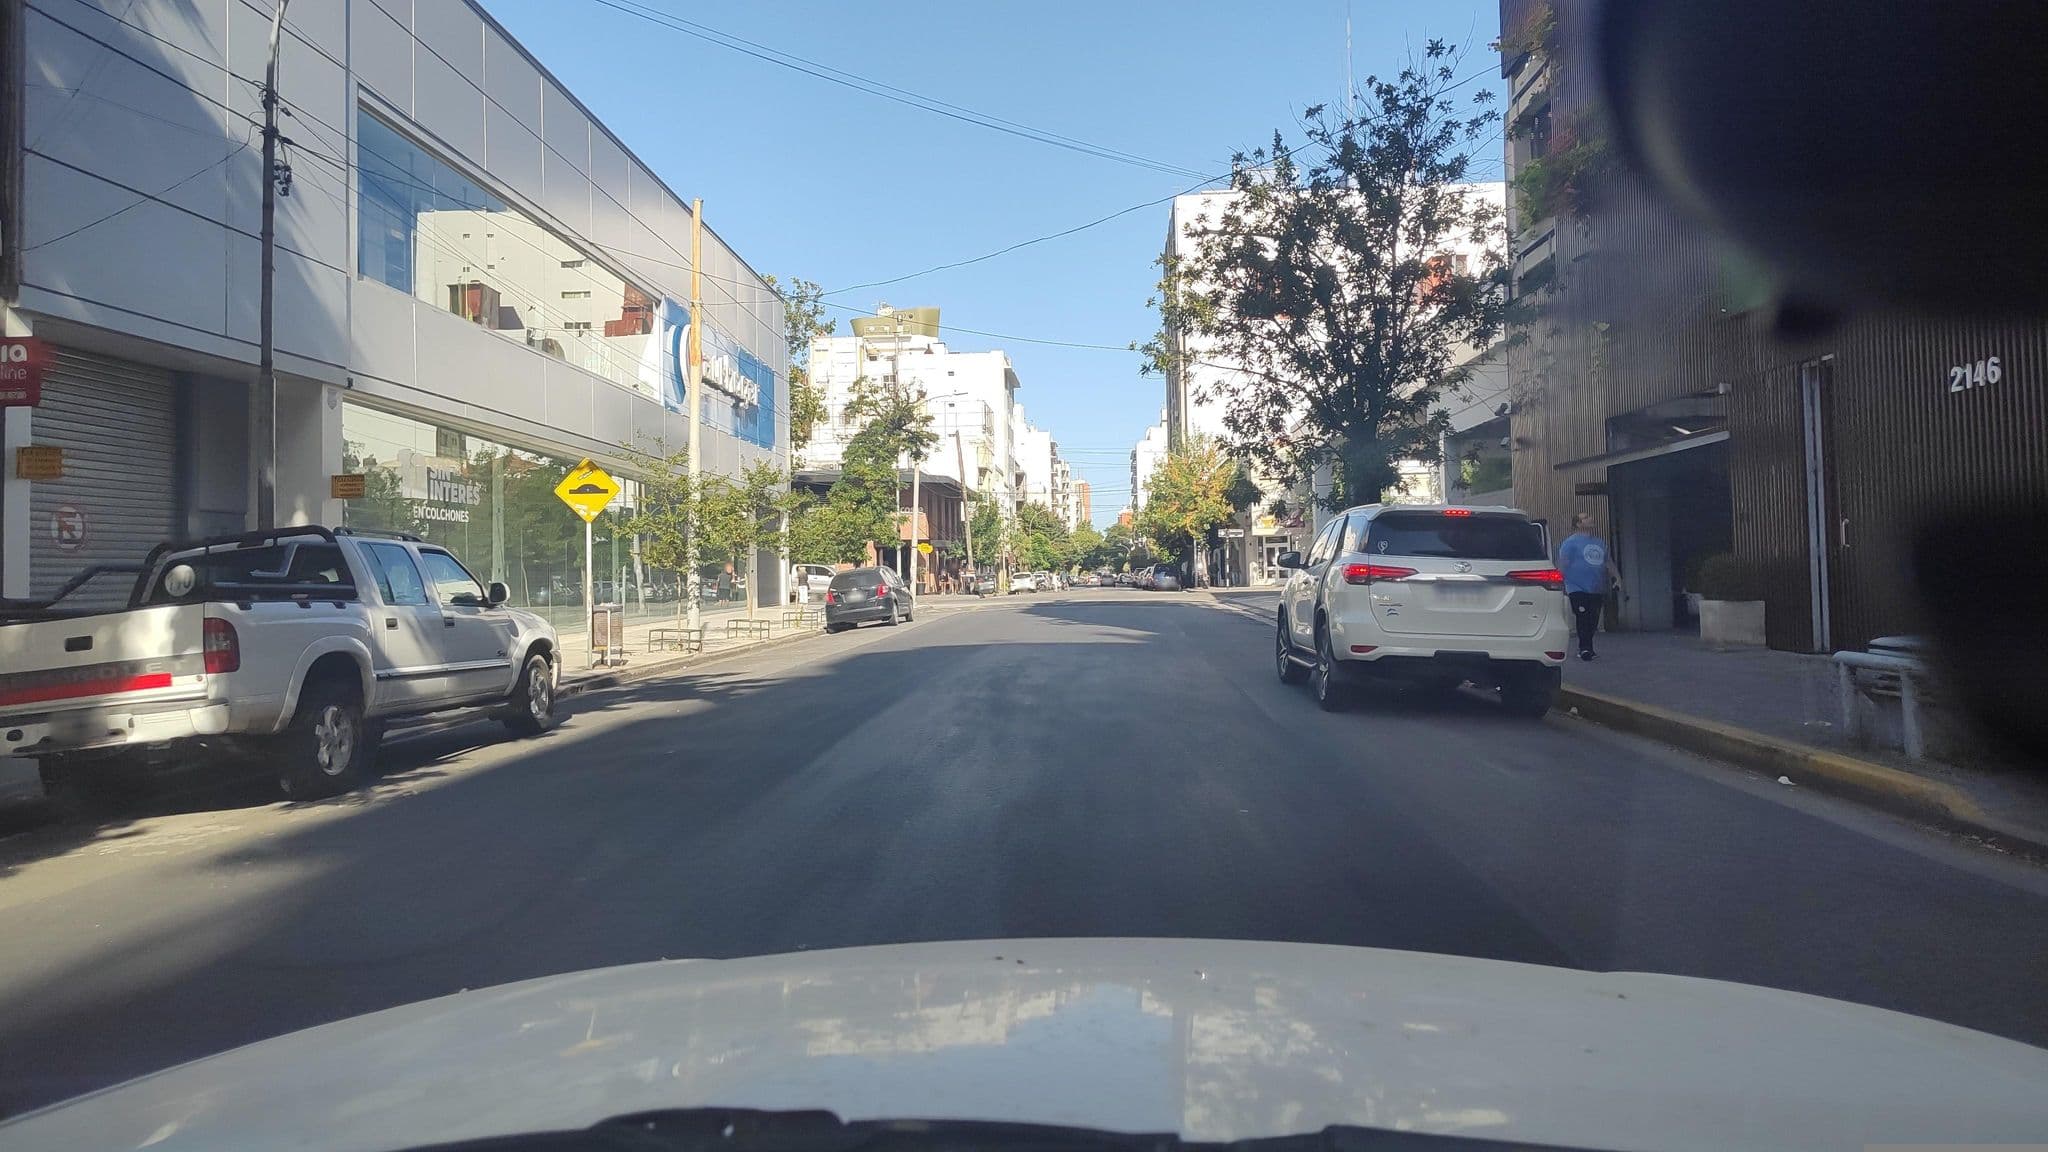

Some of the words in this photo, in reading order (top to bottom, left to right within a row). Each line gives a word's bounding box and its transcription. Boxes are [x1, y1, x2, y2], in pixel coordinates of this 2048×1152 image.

[1950, 356, 2002, 392] 2146
[413, 505, 424, 519] EN
[425, 507, 470, 523] COLCHONES
